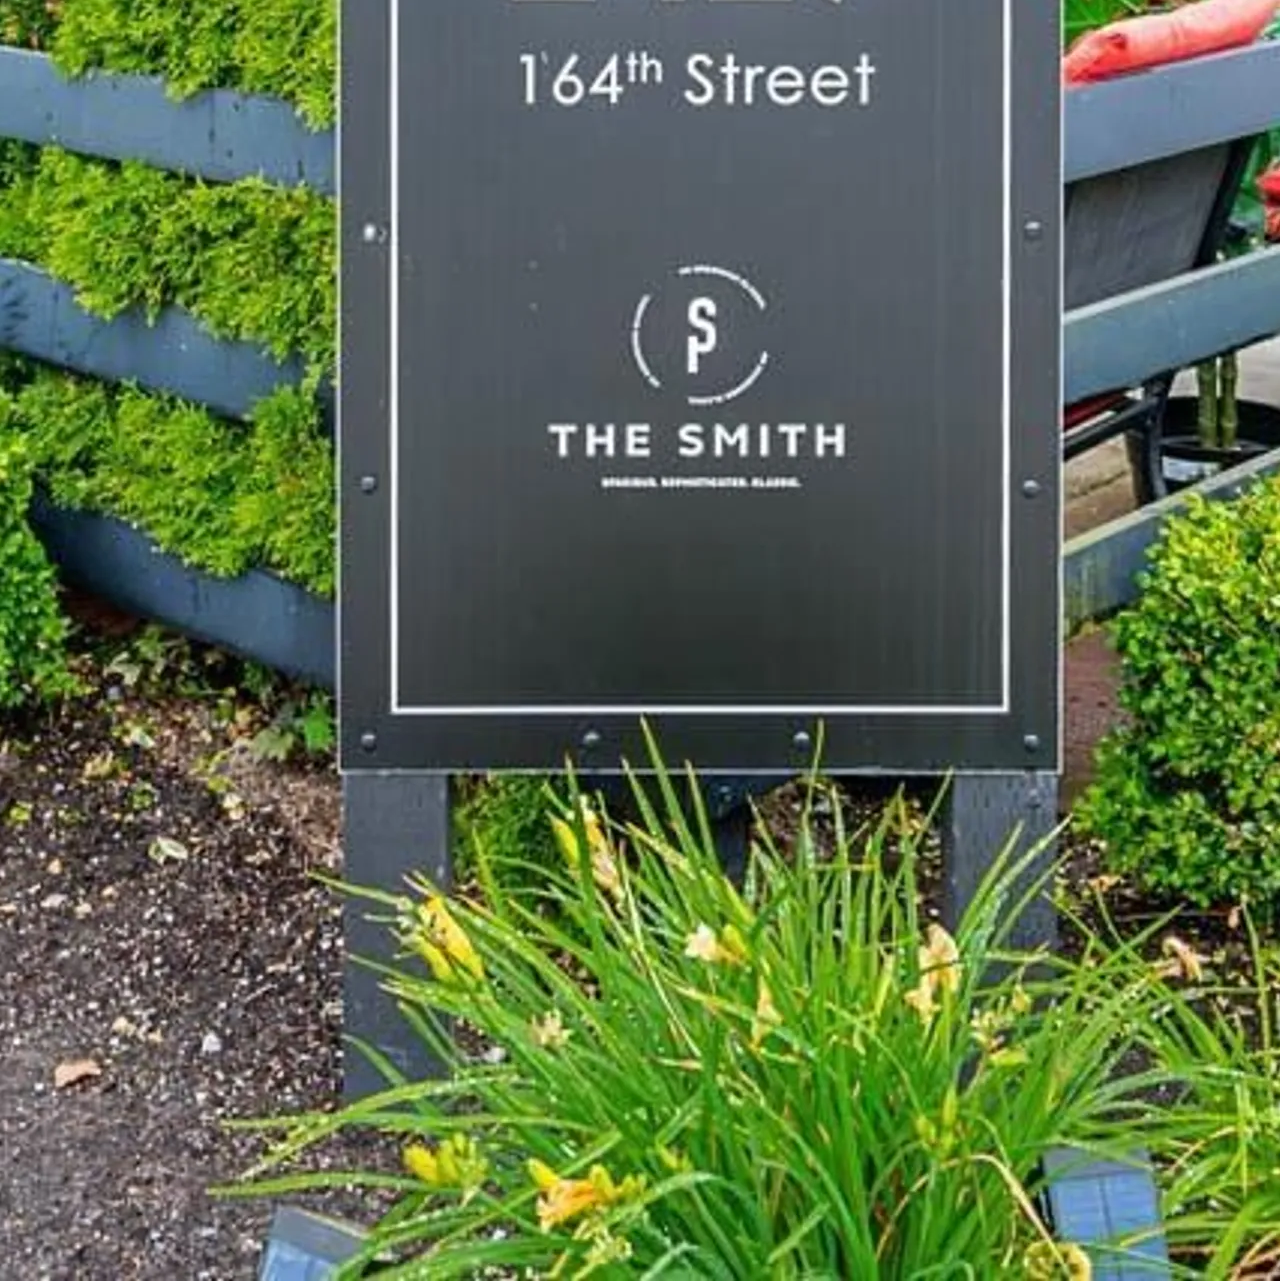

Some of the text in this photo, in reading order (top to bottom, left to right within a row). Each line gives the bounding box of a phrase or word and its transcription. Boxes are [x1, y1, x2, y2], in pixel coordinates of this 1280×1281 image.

[519, 51, 876, 106] 164th Street
[547, 423, 845, 458] THE SMITH
